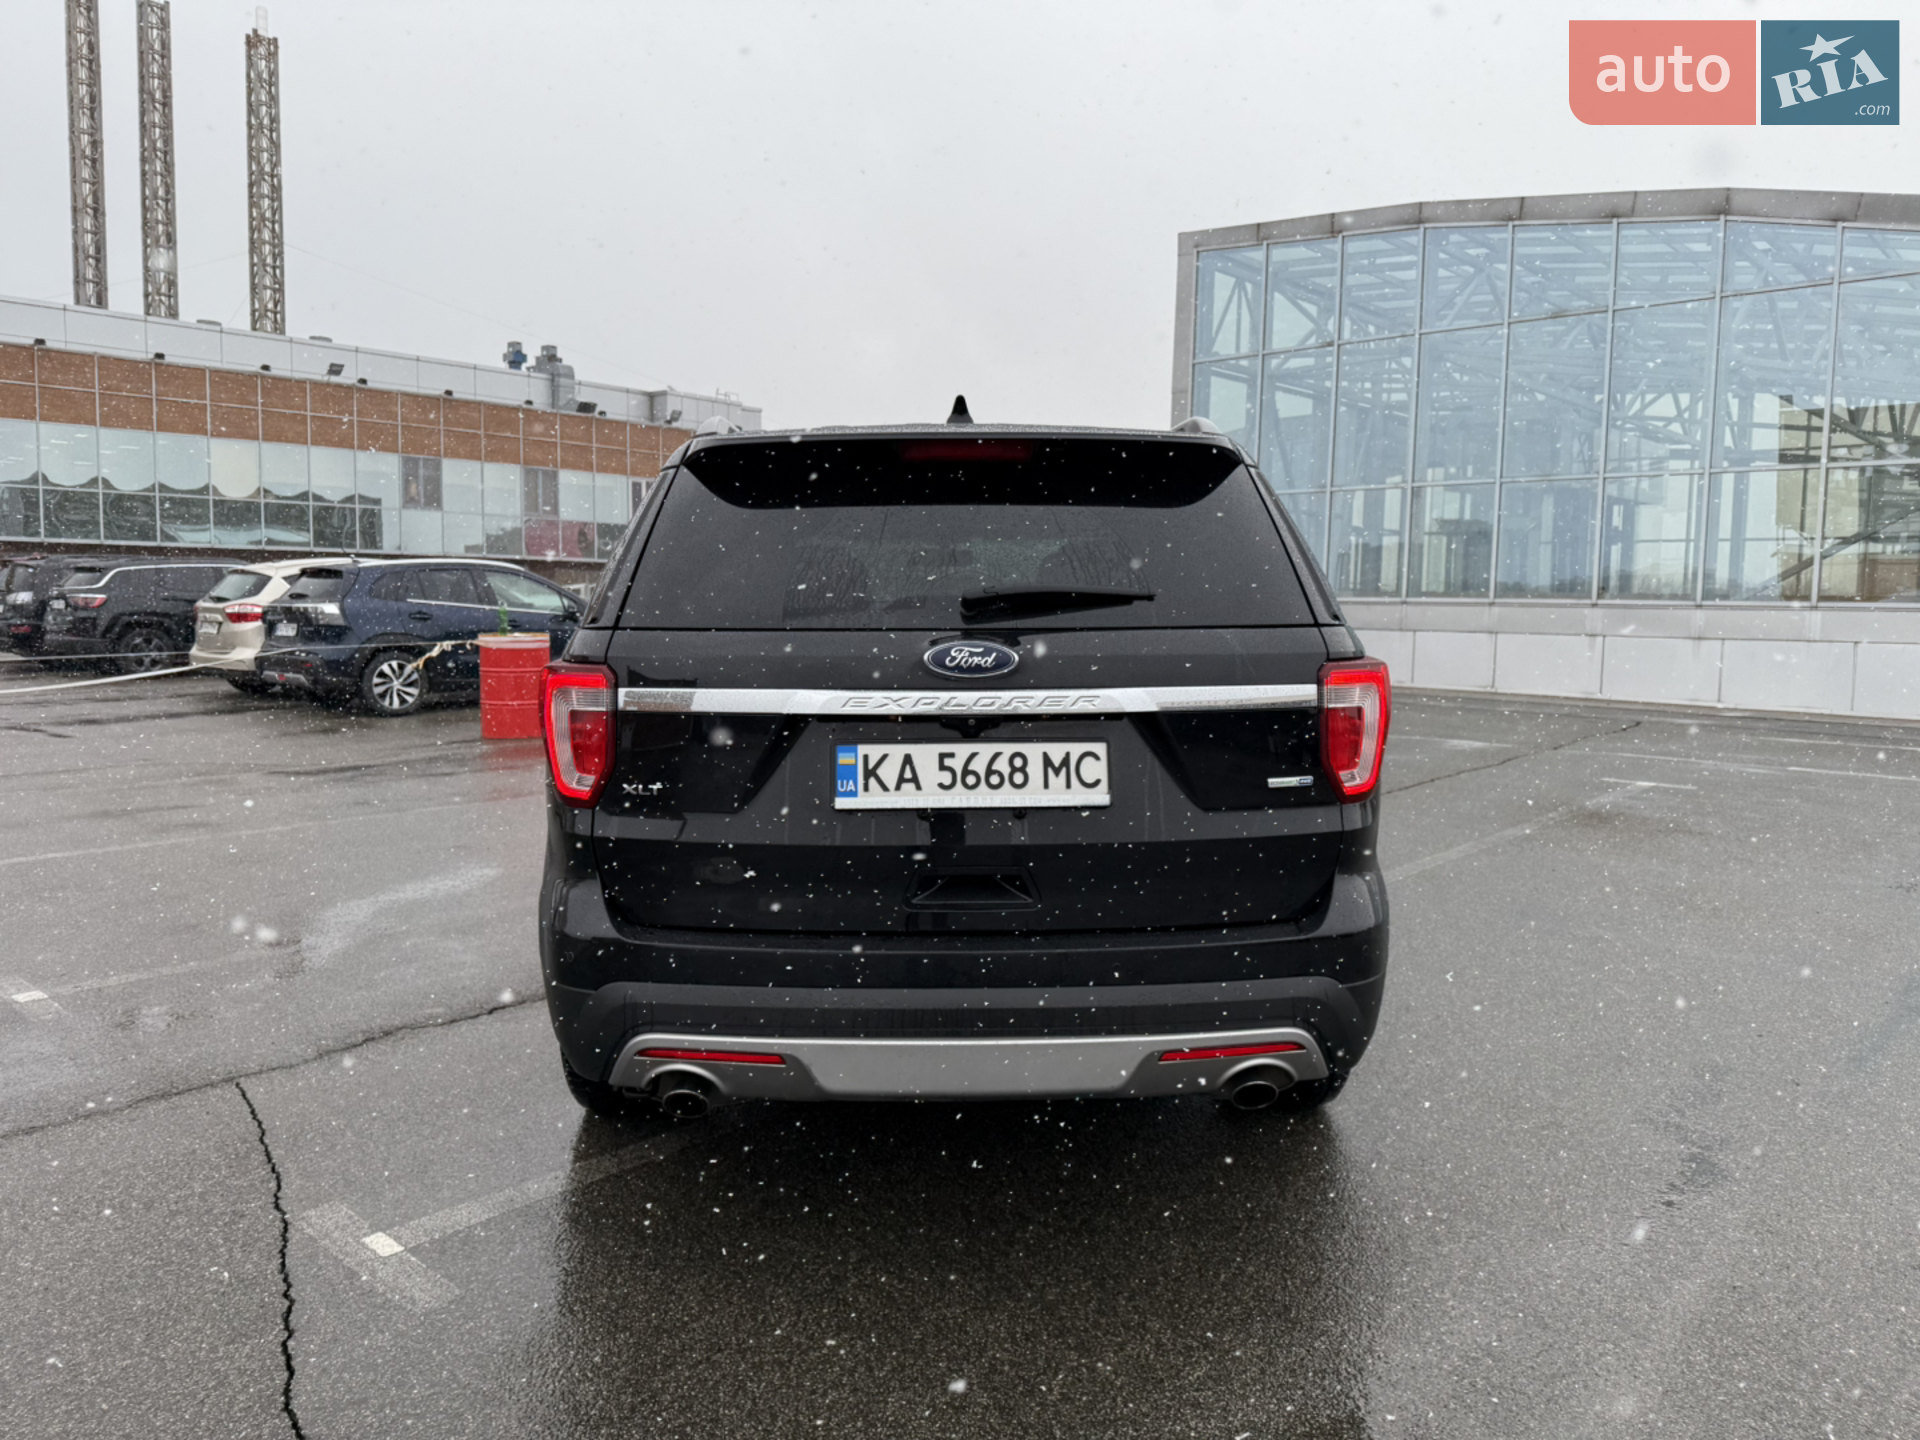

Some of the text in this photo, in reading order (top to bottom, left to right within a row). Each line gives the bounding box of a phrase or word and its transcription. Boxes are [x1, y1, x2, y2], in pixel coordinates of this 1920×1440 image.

[945, 646, 996, 668] Ford
[841, 695, 1101, 710] EXPLORER
[862, 751, 1102, 792] KA 5668 MC
[622, 783, 663, 795] XLT
[837, 779, 856, 792] UA
